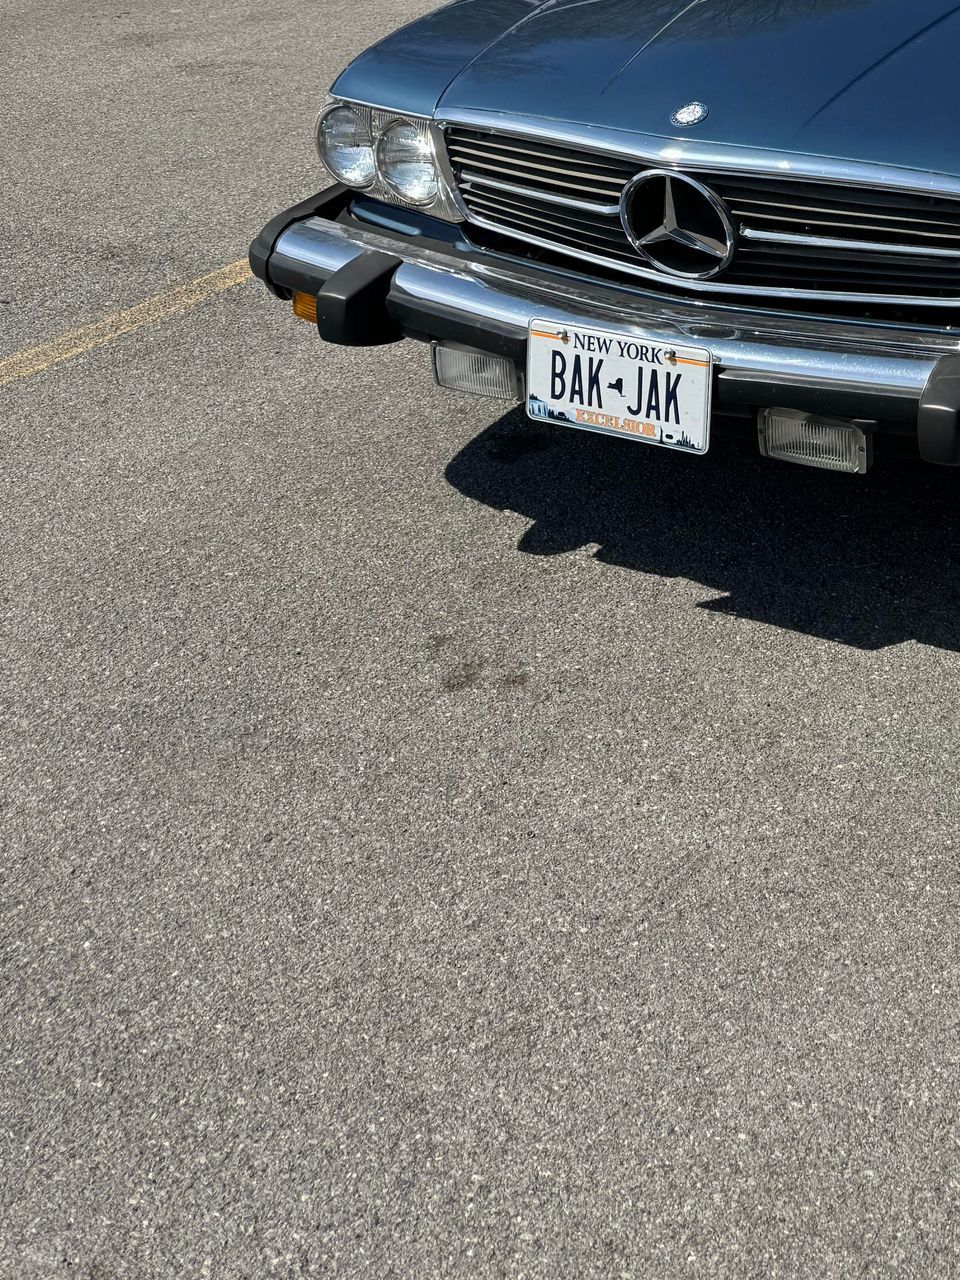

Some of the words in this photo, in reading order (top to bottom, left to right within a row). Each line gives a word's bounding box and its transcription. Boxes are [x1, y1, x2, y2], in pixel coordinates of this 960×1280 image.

[573, 332, 613, 355] NEW
[617, 341, 663, 365] YORK
[551, 349, 604, 409] BAK
[627, 366, 682, 425] JAK
[575, 408, 657, 438] EXCELSIOR
